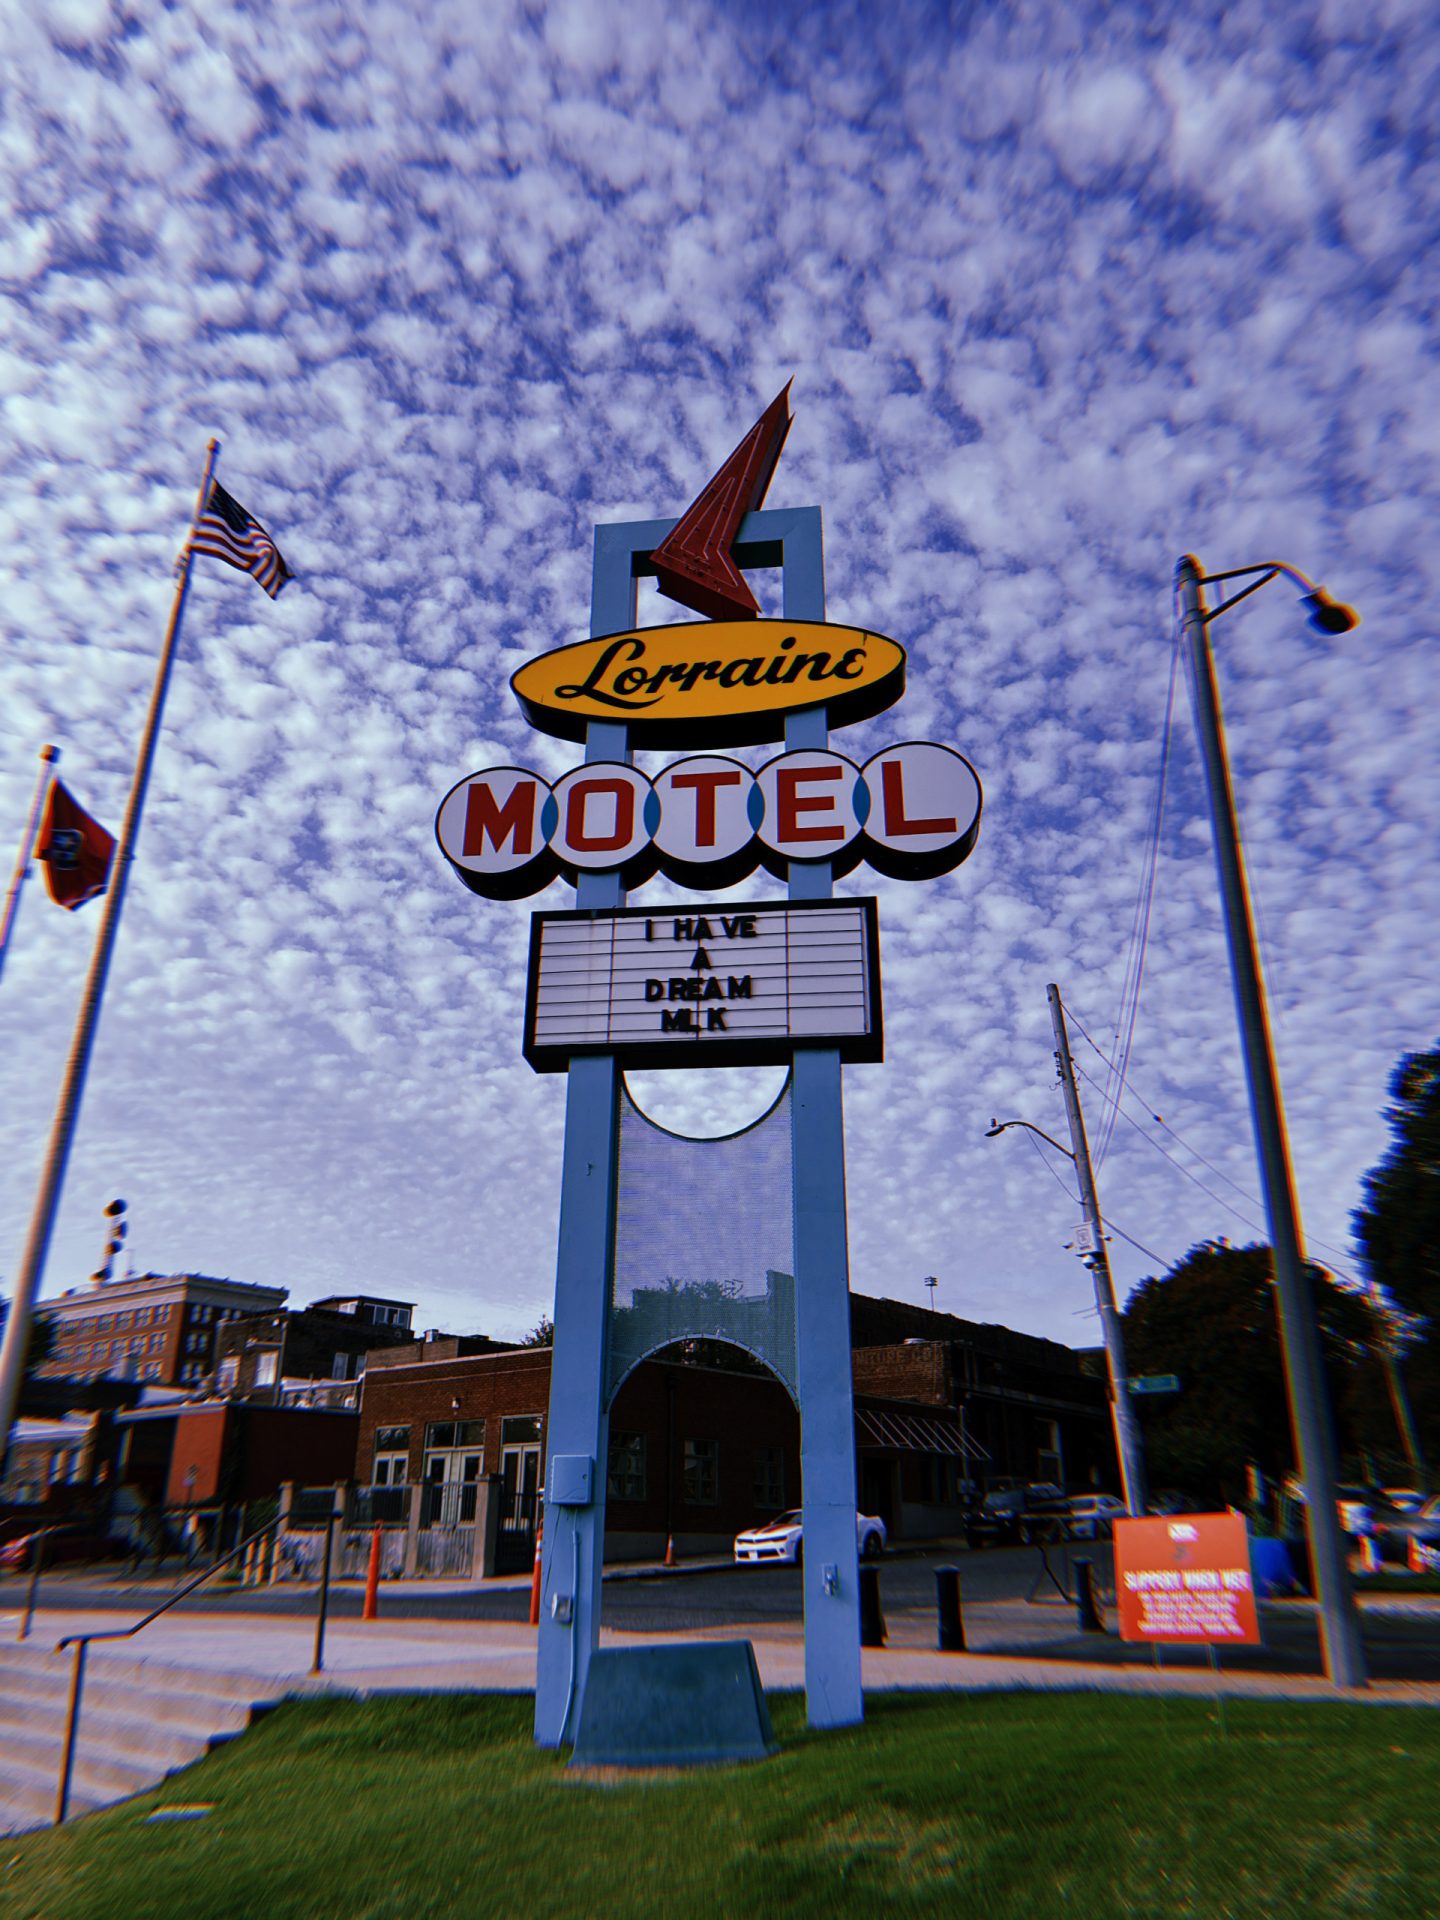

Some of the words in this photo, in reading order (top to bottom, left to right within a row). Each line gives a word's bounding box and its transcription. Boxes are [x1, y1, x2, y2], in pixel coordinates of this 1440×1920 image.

[554, 637, 867, 709] Lorraine
[462, 761, 957, 857] MOTEL
[645, 918, 653, 942] I
[674, 915, 757, 941] HAVE
[690, 946, 713, 970] A
[645, 975, 753, 1002] DREAM
[661, 1007, 727, 1032] MLK
